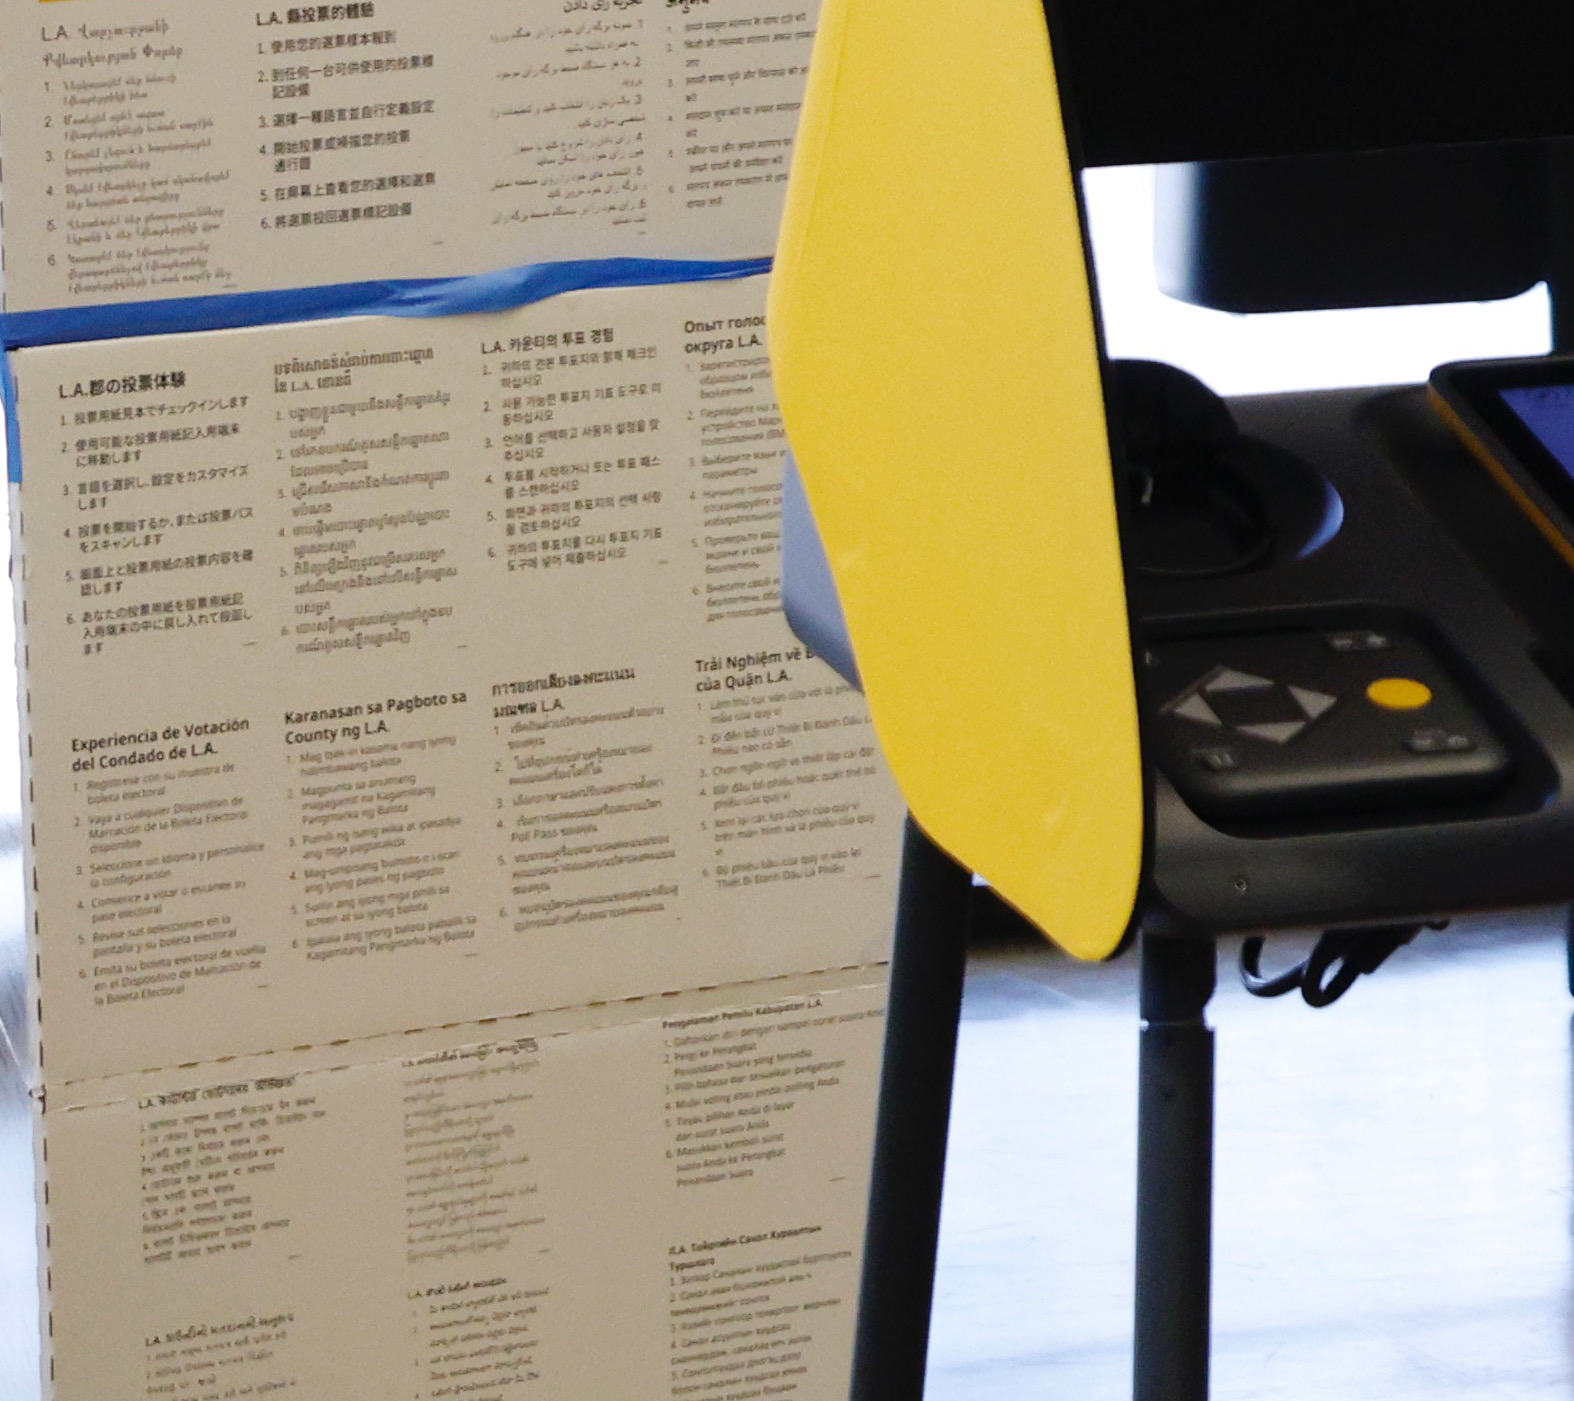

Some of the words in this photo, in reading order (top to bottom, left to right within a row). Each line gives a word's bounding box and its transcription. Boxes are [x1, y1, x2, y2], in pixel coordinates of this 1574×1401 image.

[256, 12, 282, 26] L.A.
[481, 341, 506, 354] L.A.
[738, 334, 762, 347] L.A.
[767, 670, 792, 683] L.A.
[285, 706, 362, 724] Karanasan
[367, 704, 382, 714] sa
[387, 695, 447, 713] Pagboto
[452, 693, 466, 703] sa
[72, 732, 157, 755] Experiencia
[162, 727, 179, 740] de
[184, 720, 249, 737] Votación
[285, 729, 338, 744] County
[342, 726, 360, 740] ng
[72, 757, 94, 772] del
[100, 749, 164, 768] Condado
[169, 746, 186, 759] de
[191, 742, 218, 757] L.A.
